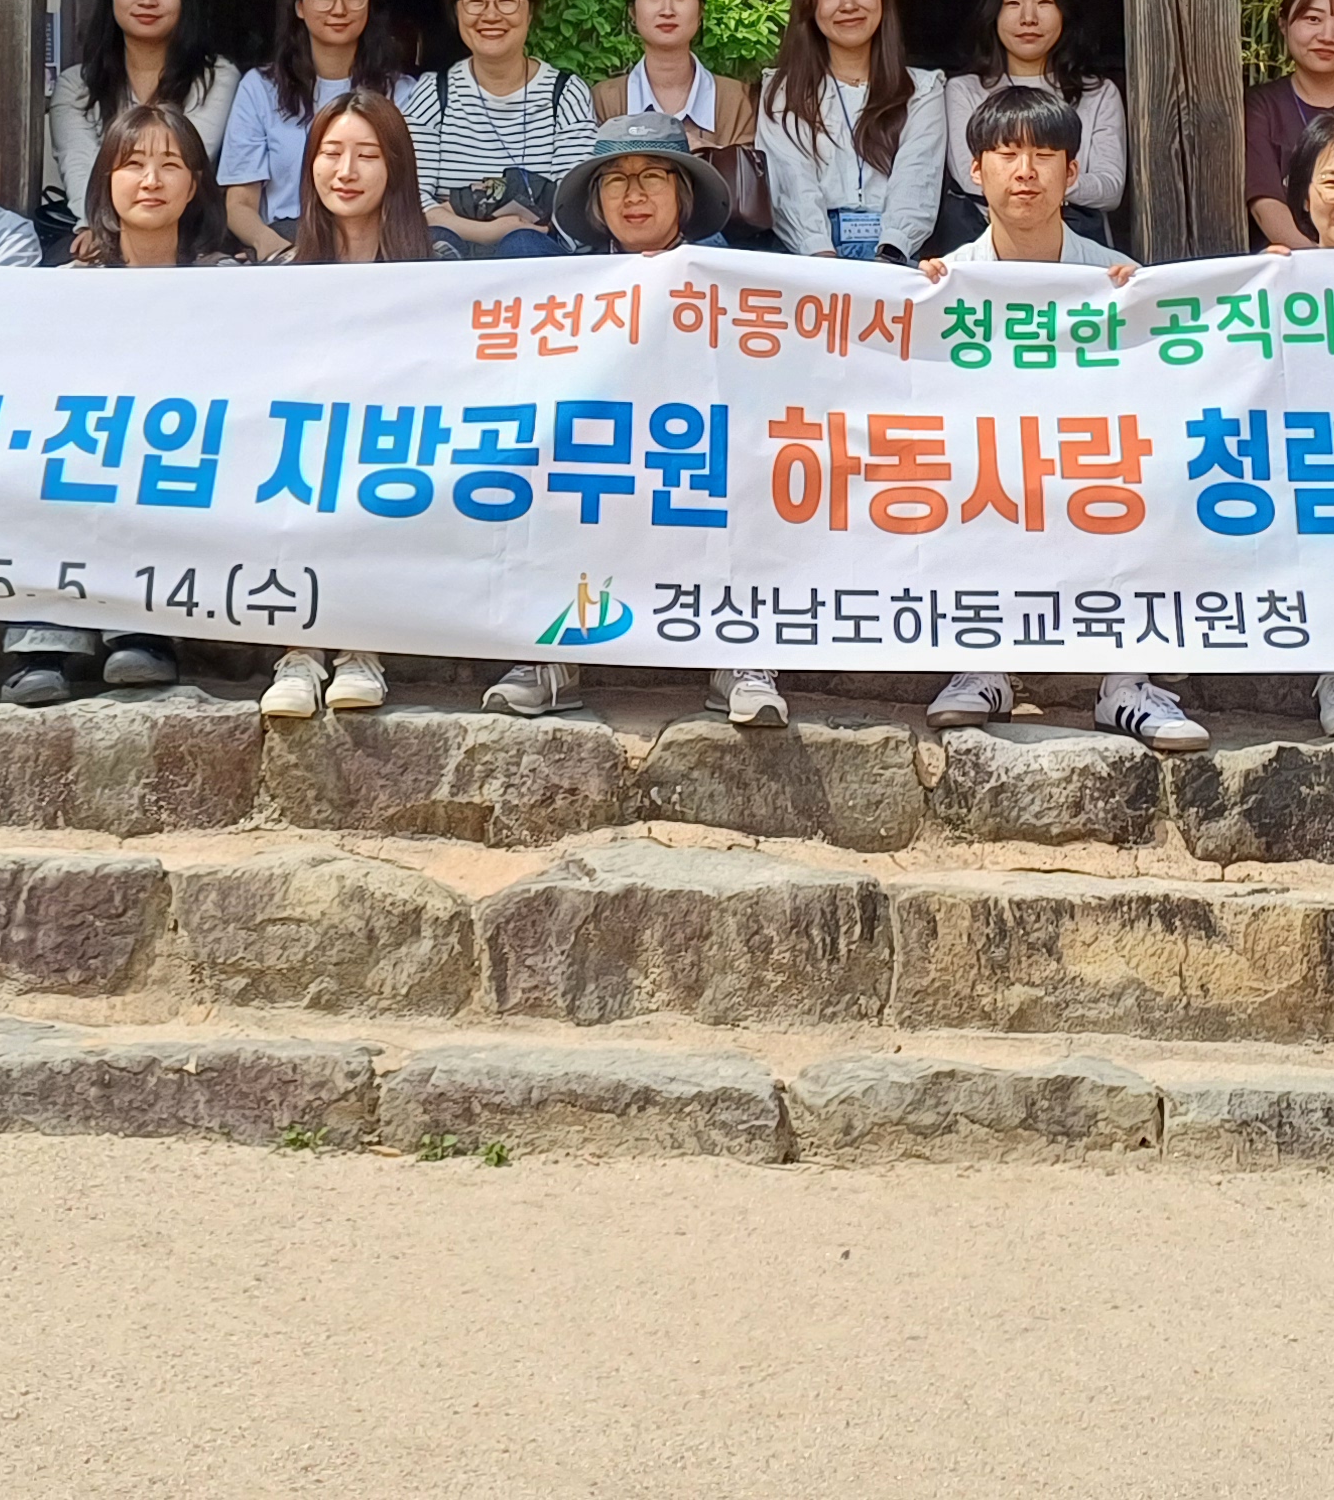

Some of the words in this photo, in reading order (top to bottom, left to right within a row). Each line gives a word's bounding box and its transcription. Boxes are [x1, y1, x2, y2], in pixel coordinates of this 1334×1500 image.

[471, 285, 641, 361] 별천지
[669, 281, 914, 361] 하동에서
[940, 298, 1127, 370] 청렴한
[254, 399, 730, 529] 지방공무원
[768, 406, 1153, 535] 하동사랑
[134, 563, 319, 630] 14.(수)
[652, 583, 1310, 650] 경상남도하동교육지원청
